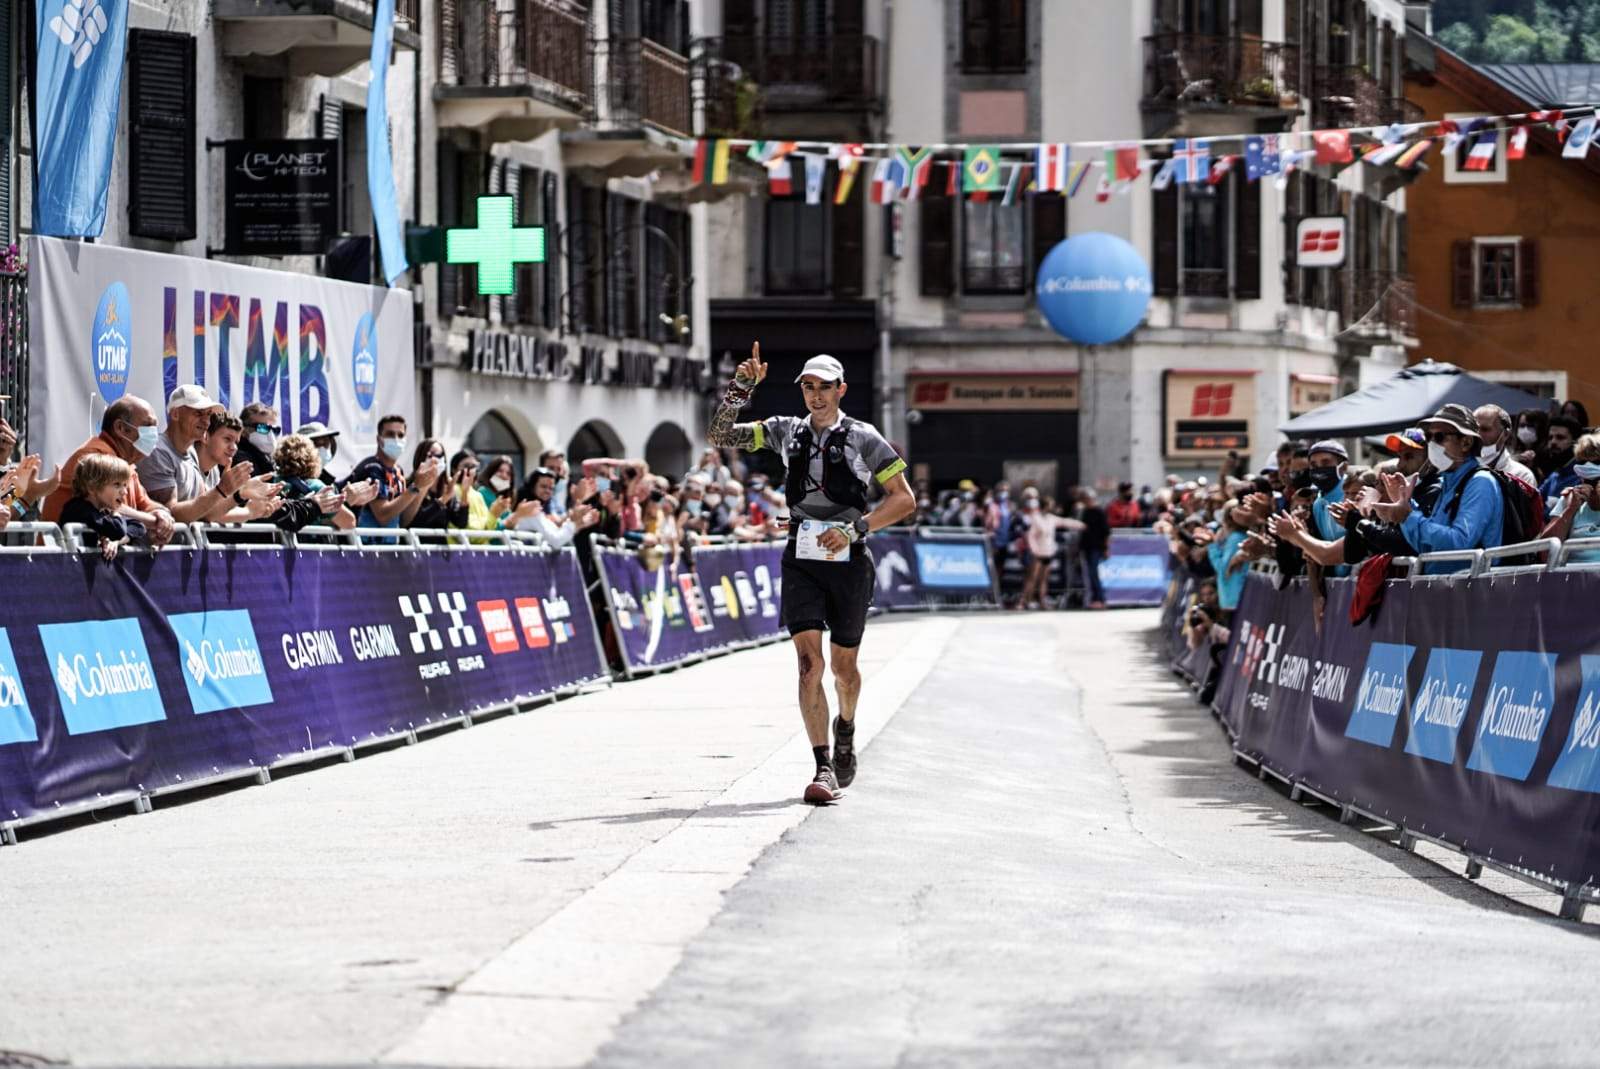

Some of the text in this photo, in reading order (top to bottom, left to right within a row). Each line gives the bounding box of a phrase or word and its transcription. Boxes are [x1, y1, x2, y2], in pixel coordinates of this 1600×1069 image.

[254, 152, 326, 165] PLANET
[274, 166, 327, 176] HI-TECH
[98, 344, 128, 371] UTMB
[162, 286, 330, 438] UTMB
[201, 638, 262, 681] Columbia
[281, 630, 343, 671] GARMIN
[349, 624, 400, 662] GARMIN
[74, 650, 154, 698] Columbia
[1365, 670, 1404, 716] Columbia
[1424, 679, 1468, 728] Columbia
[1489, 685, 1547, 742] Columbia
